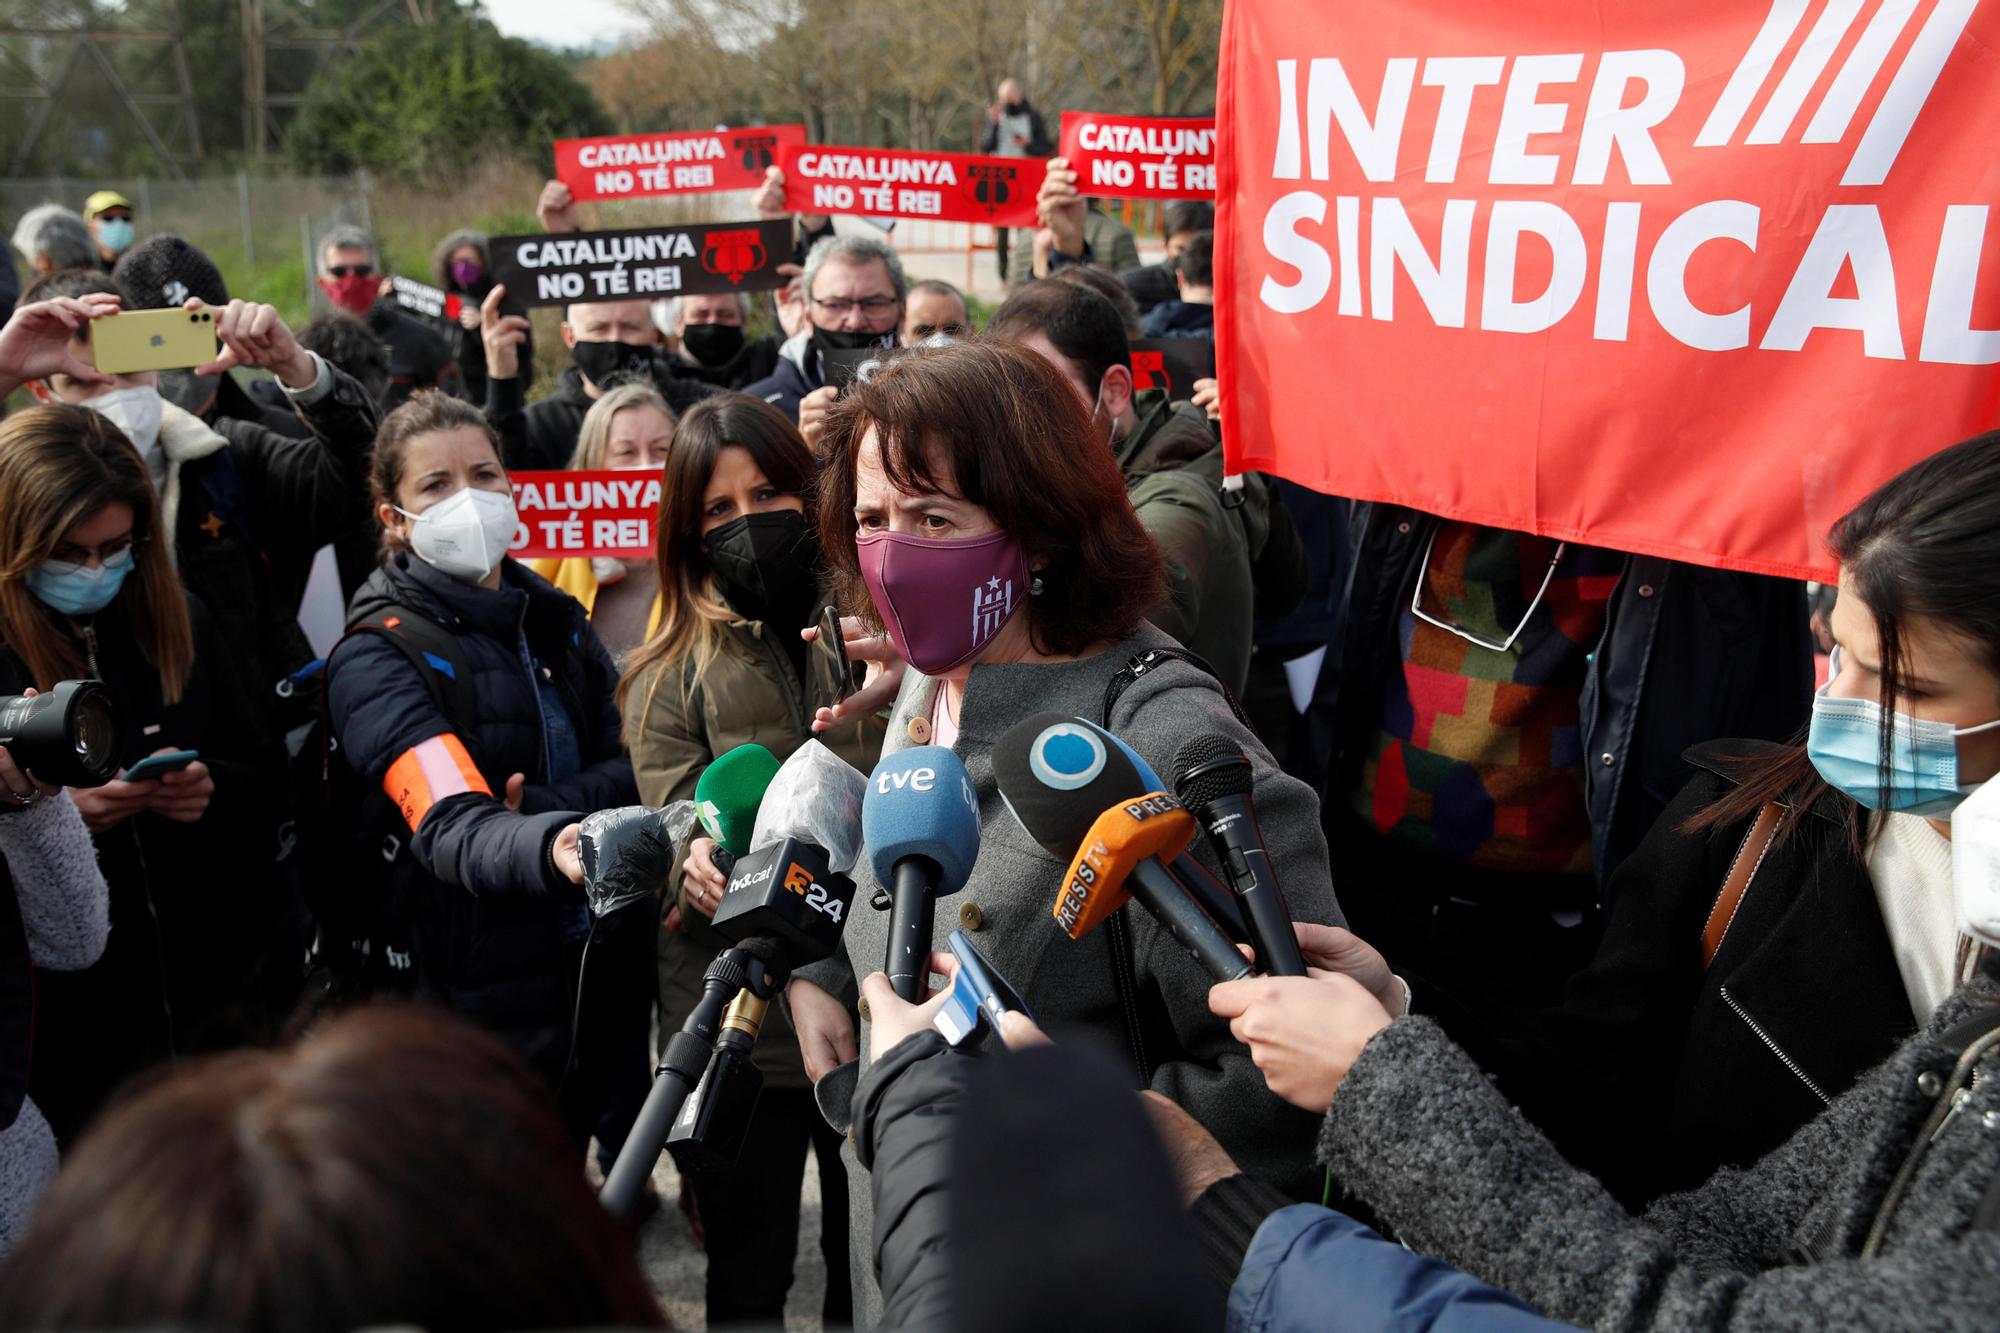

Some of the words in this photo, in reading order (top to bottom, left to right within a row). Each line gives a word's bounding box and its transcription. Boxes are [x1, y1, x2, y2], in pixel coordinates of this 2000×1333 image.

[1272, 49, 1685, 185] INTER
[578, 137, 726, 167] CATALUNYA
[1078, 123, 1216, 156] CATALUN
[594, 172, 634, 194] NO
[638, 163, 671, 190] TÉ
[673, 165, 714, 188] REI
[798, 153, 957, 185] CATALUNYA
[1092, 159, 1135, 187] NO
[1140, 156, 1178, 190] TÉ
[813, 184, 854, 208] NO
[859, 183, 894, 211] TÉ
[898, 189, 941, 214] REI
[517, 233, 696, 268] CATALUNYA
[537, 273, 584, 299] NO
[590, 263, 629, 295] TÉ
[634, 266, 682, 292] REI
[1259, 191, 2000, 365] SINDICAL
[512, 480, 662, 511] ALUNYA
[509, 522, 531, 550] O
[538, 511, 584, 549] TÉ
[592, 519, 649, 548] REI
[877, 767, 936, 794] tve
[729, 864, 773, 893] tv3.cat
